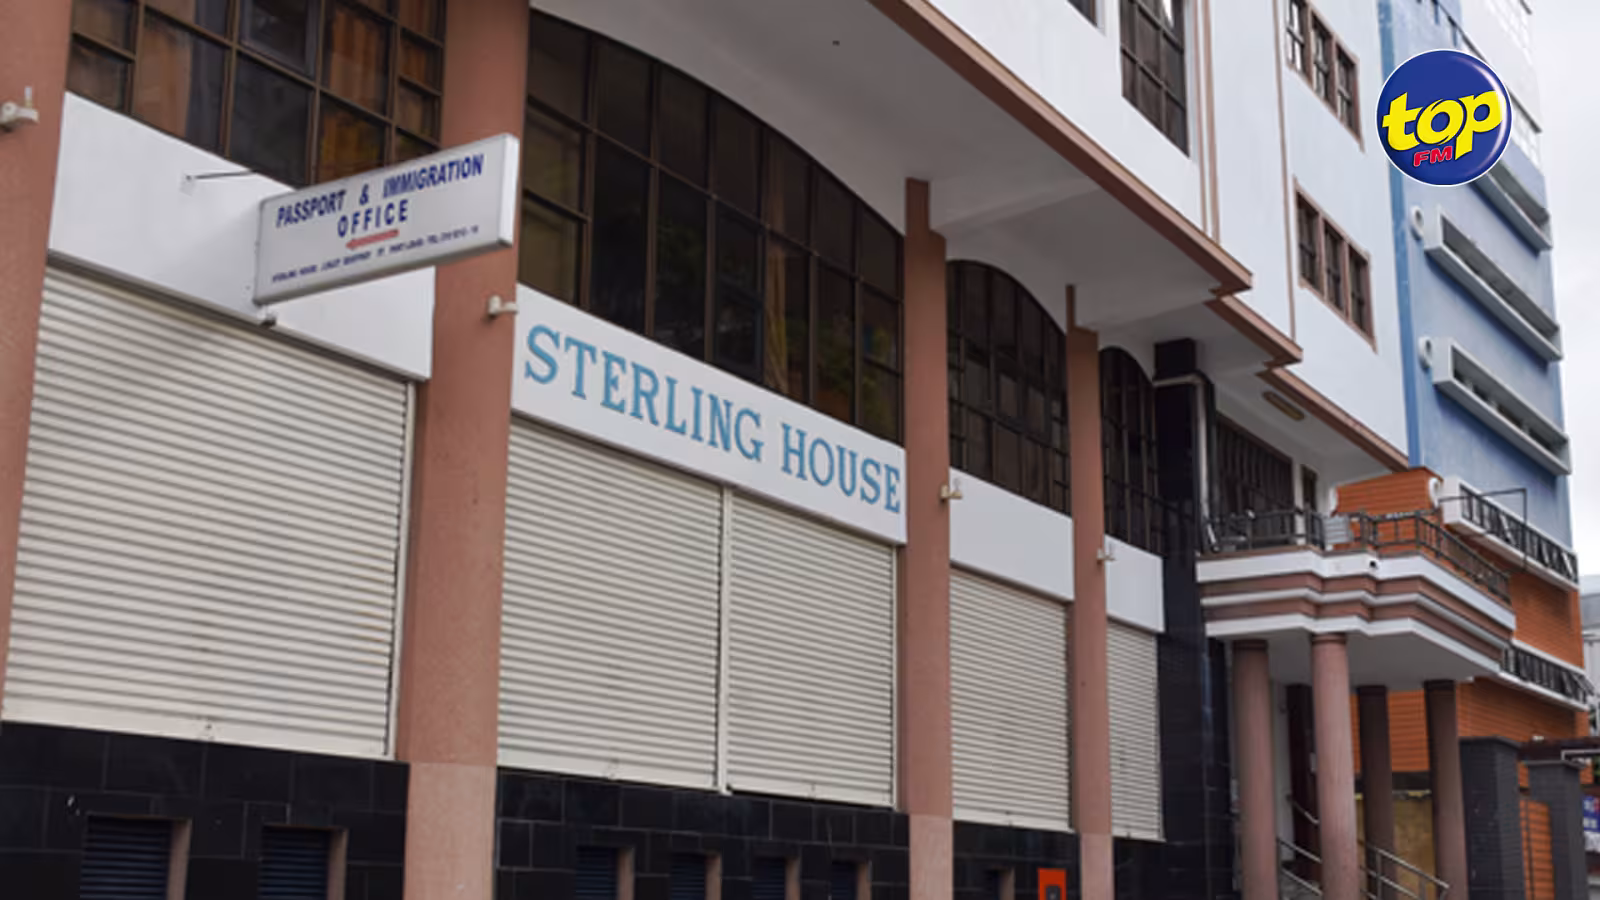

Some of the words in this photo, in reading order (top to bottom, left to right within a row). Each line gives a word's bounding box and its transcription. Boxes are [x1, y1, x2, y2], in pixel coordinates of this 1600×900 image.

[276, 190, 346, 228] PASSPORT
[359, 184, 369, 206] &
[383, 154, 485, 198] IMMIGRATION
[337, 199, 409, 238] OFFICE
[524, 324, 765, 463] STERLING
[781, 421, 901, 514] HOUSE
